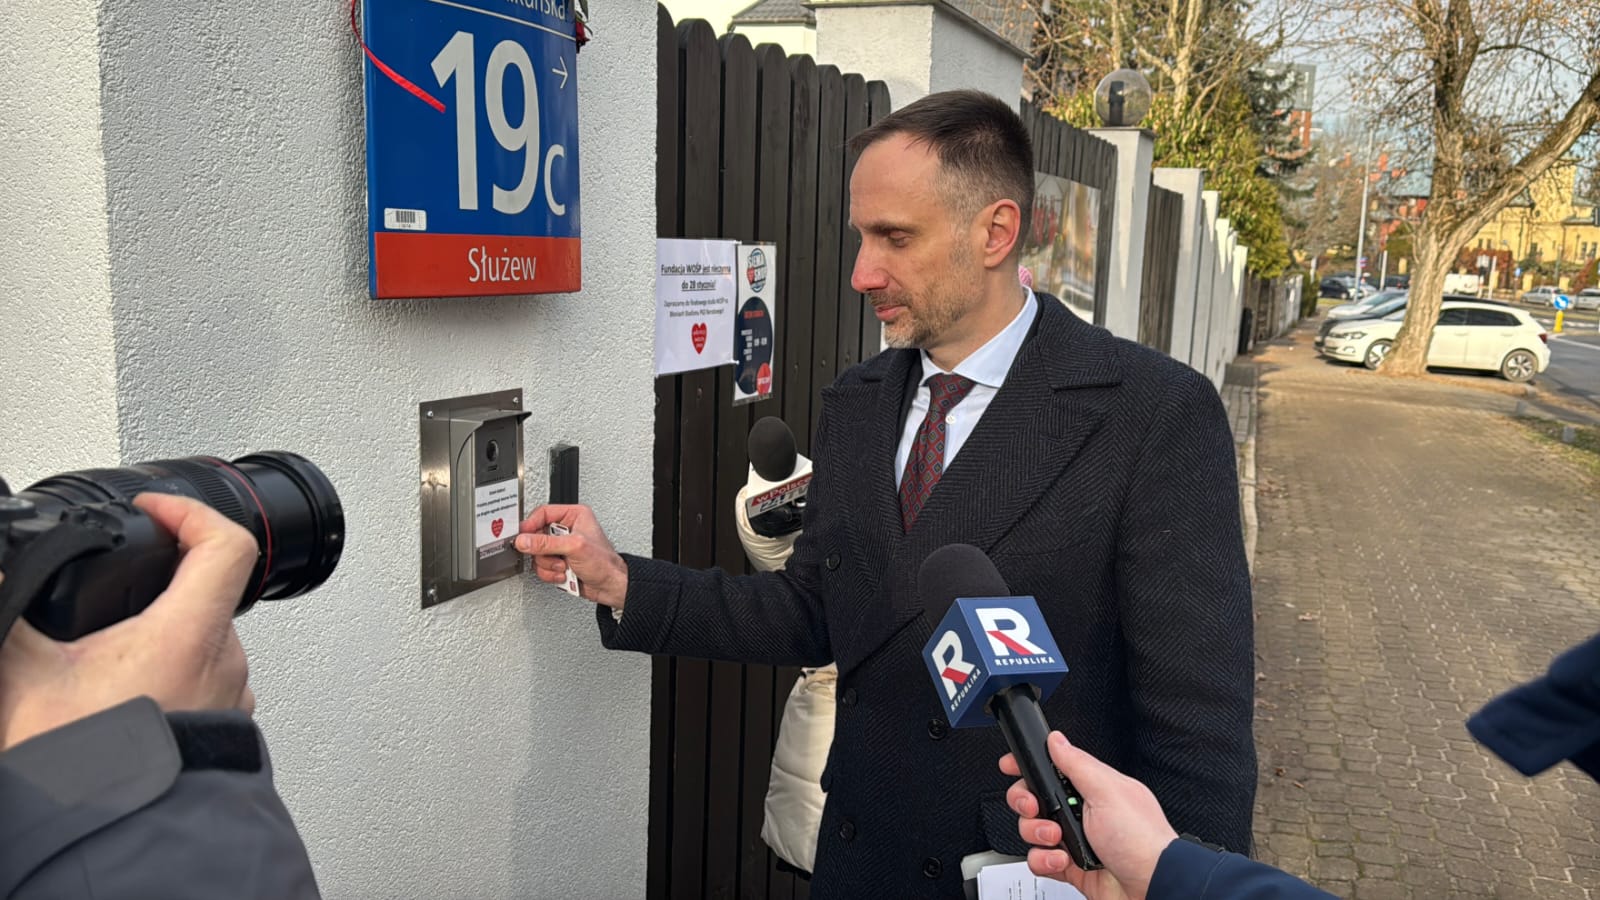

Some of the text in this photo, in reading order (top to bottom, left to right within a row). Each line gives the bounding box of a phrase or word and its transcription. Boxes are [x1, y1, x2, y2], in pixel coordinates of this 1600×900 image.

[468, 247, 537, 283] Służew
[661, 264, 685, 275] Fundacja
[686, 261, 702, 273] WOŚP
[702, 265, 711, 275] jest
[681, 280, 688, 289] do
[689, 280, 696, 289] 28
[975, 608, 1047, 656] R
[931, 630, 975, 701] R
[994, 657, 1055, 666] REPUBLIKA
[950, 668, 982, 712] REPUBLIKA
